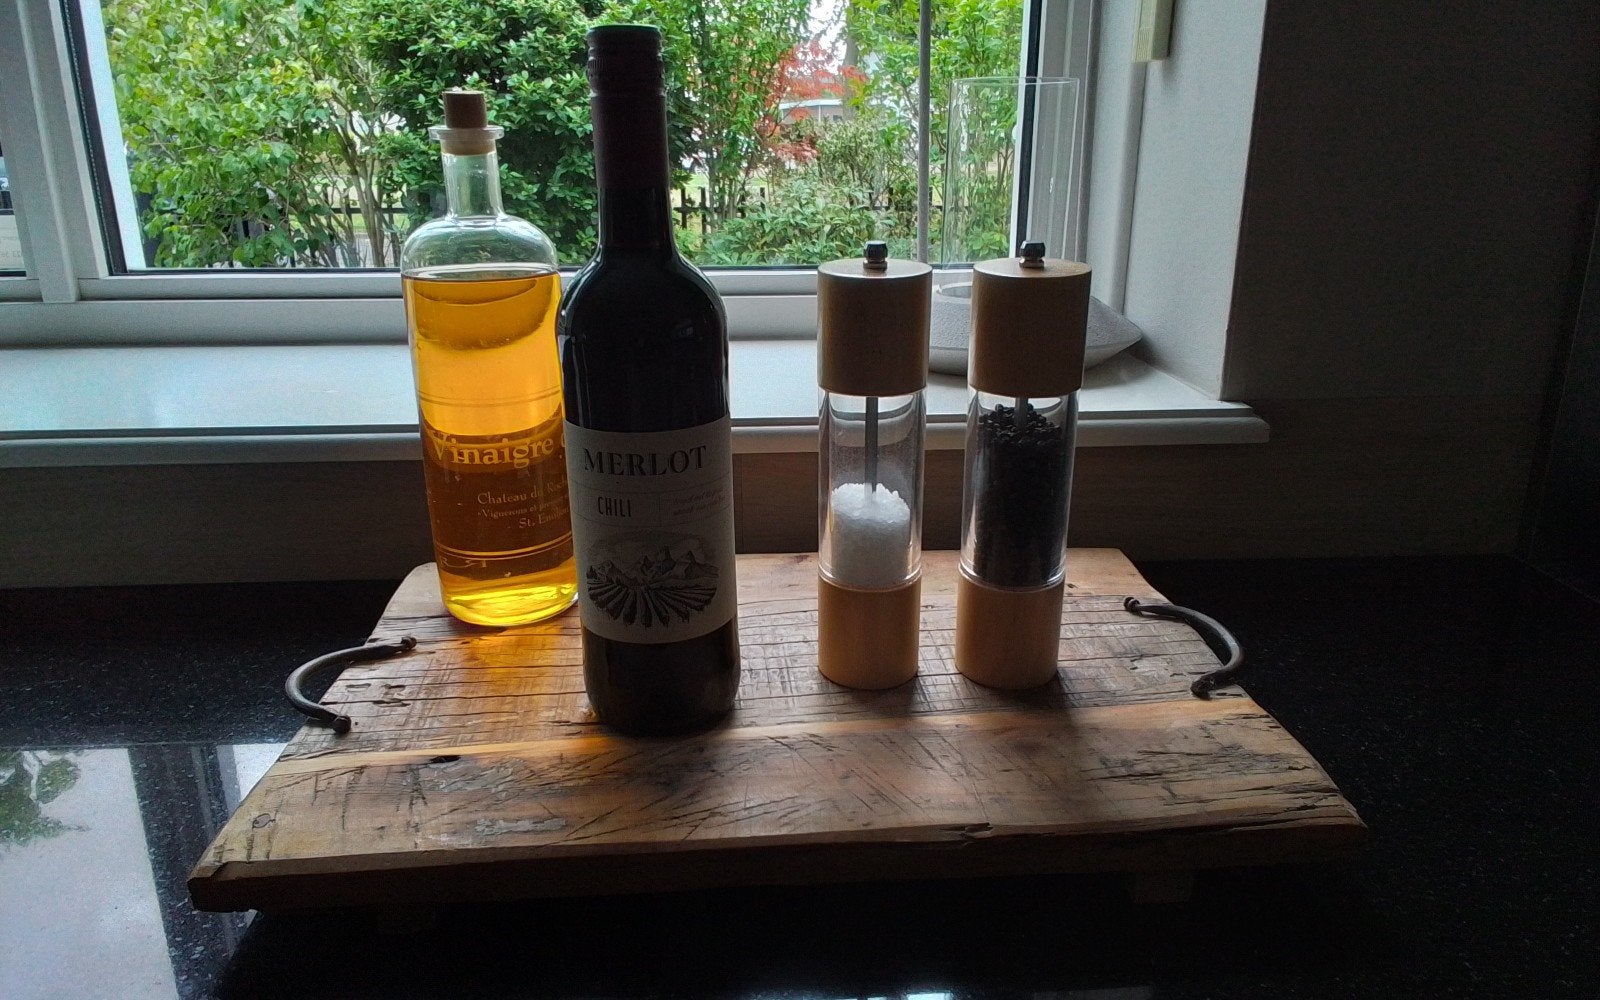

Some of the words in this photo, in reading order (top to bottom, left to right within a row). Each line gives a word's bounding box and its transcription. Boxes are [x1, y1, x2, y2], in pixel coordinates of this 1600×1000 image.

[430, 431, 554, 469] Vinaigre
[583, 445, 707, 476] MERLOT
[477, 491, 527, 505] Chateau
[597, 496, 632, 518] CHILI
